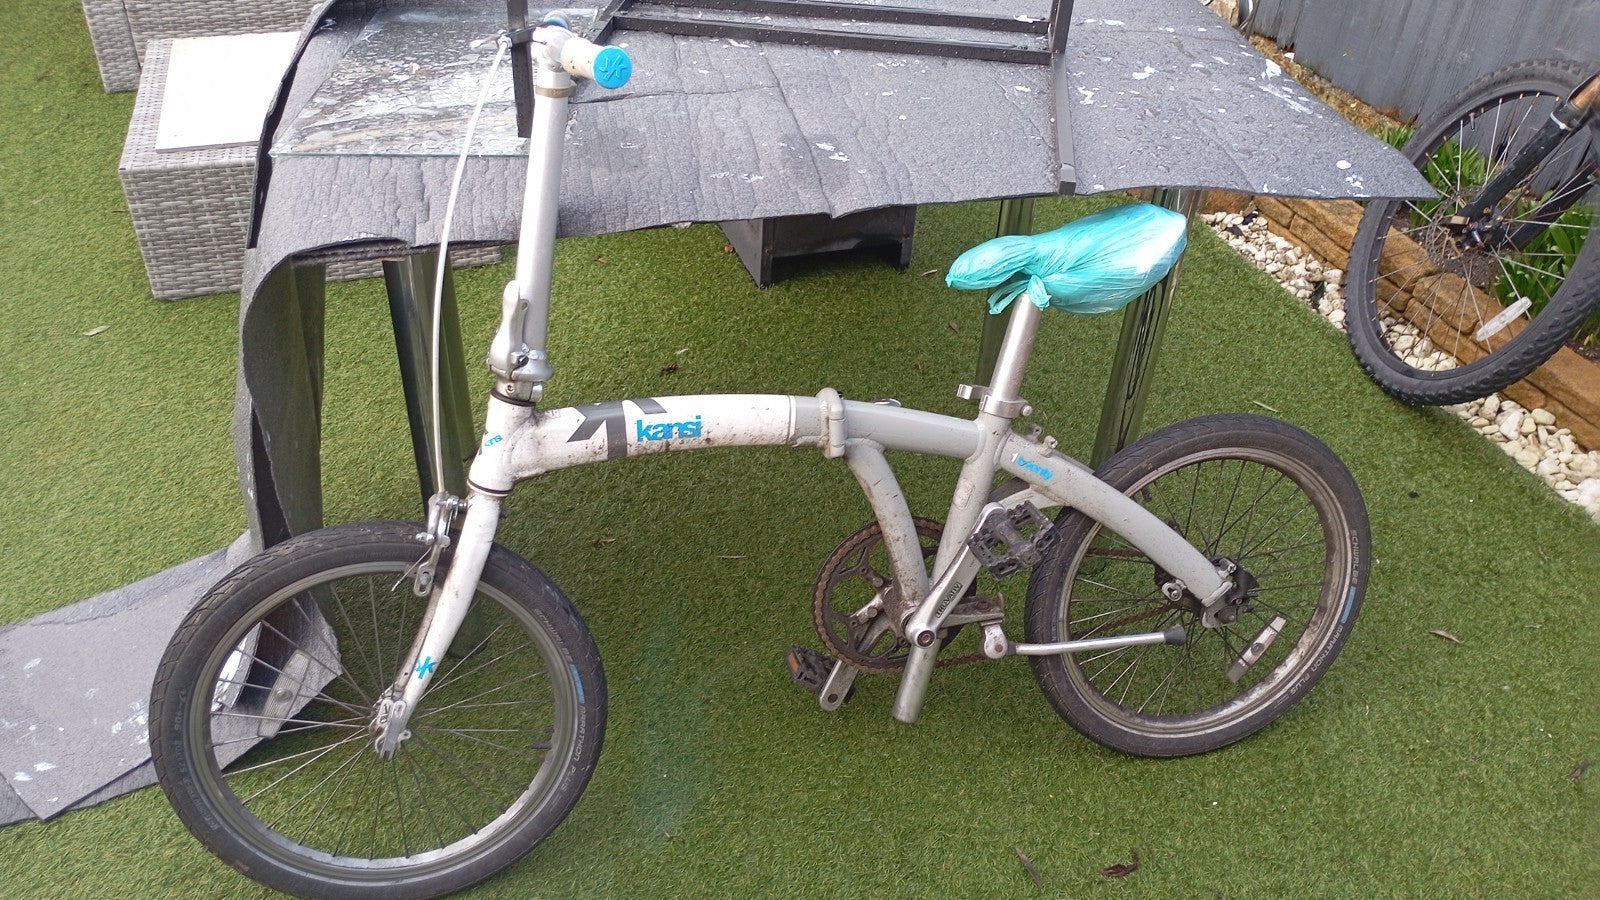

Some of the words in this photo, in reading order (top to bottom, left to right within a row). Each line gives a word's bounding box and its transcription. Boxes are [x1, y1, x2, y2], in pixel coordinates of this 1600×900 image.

[636, 415, 702, 442] kansi
[1352, 529, 1360, 585] SCHWALBE
[935, 581, 964, 619] TRUVATIV
[1311, 624, 1344, 672] MARATHON
[573, 705, 586, 762] MARATHON
